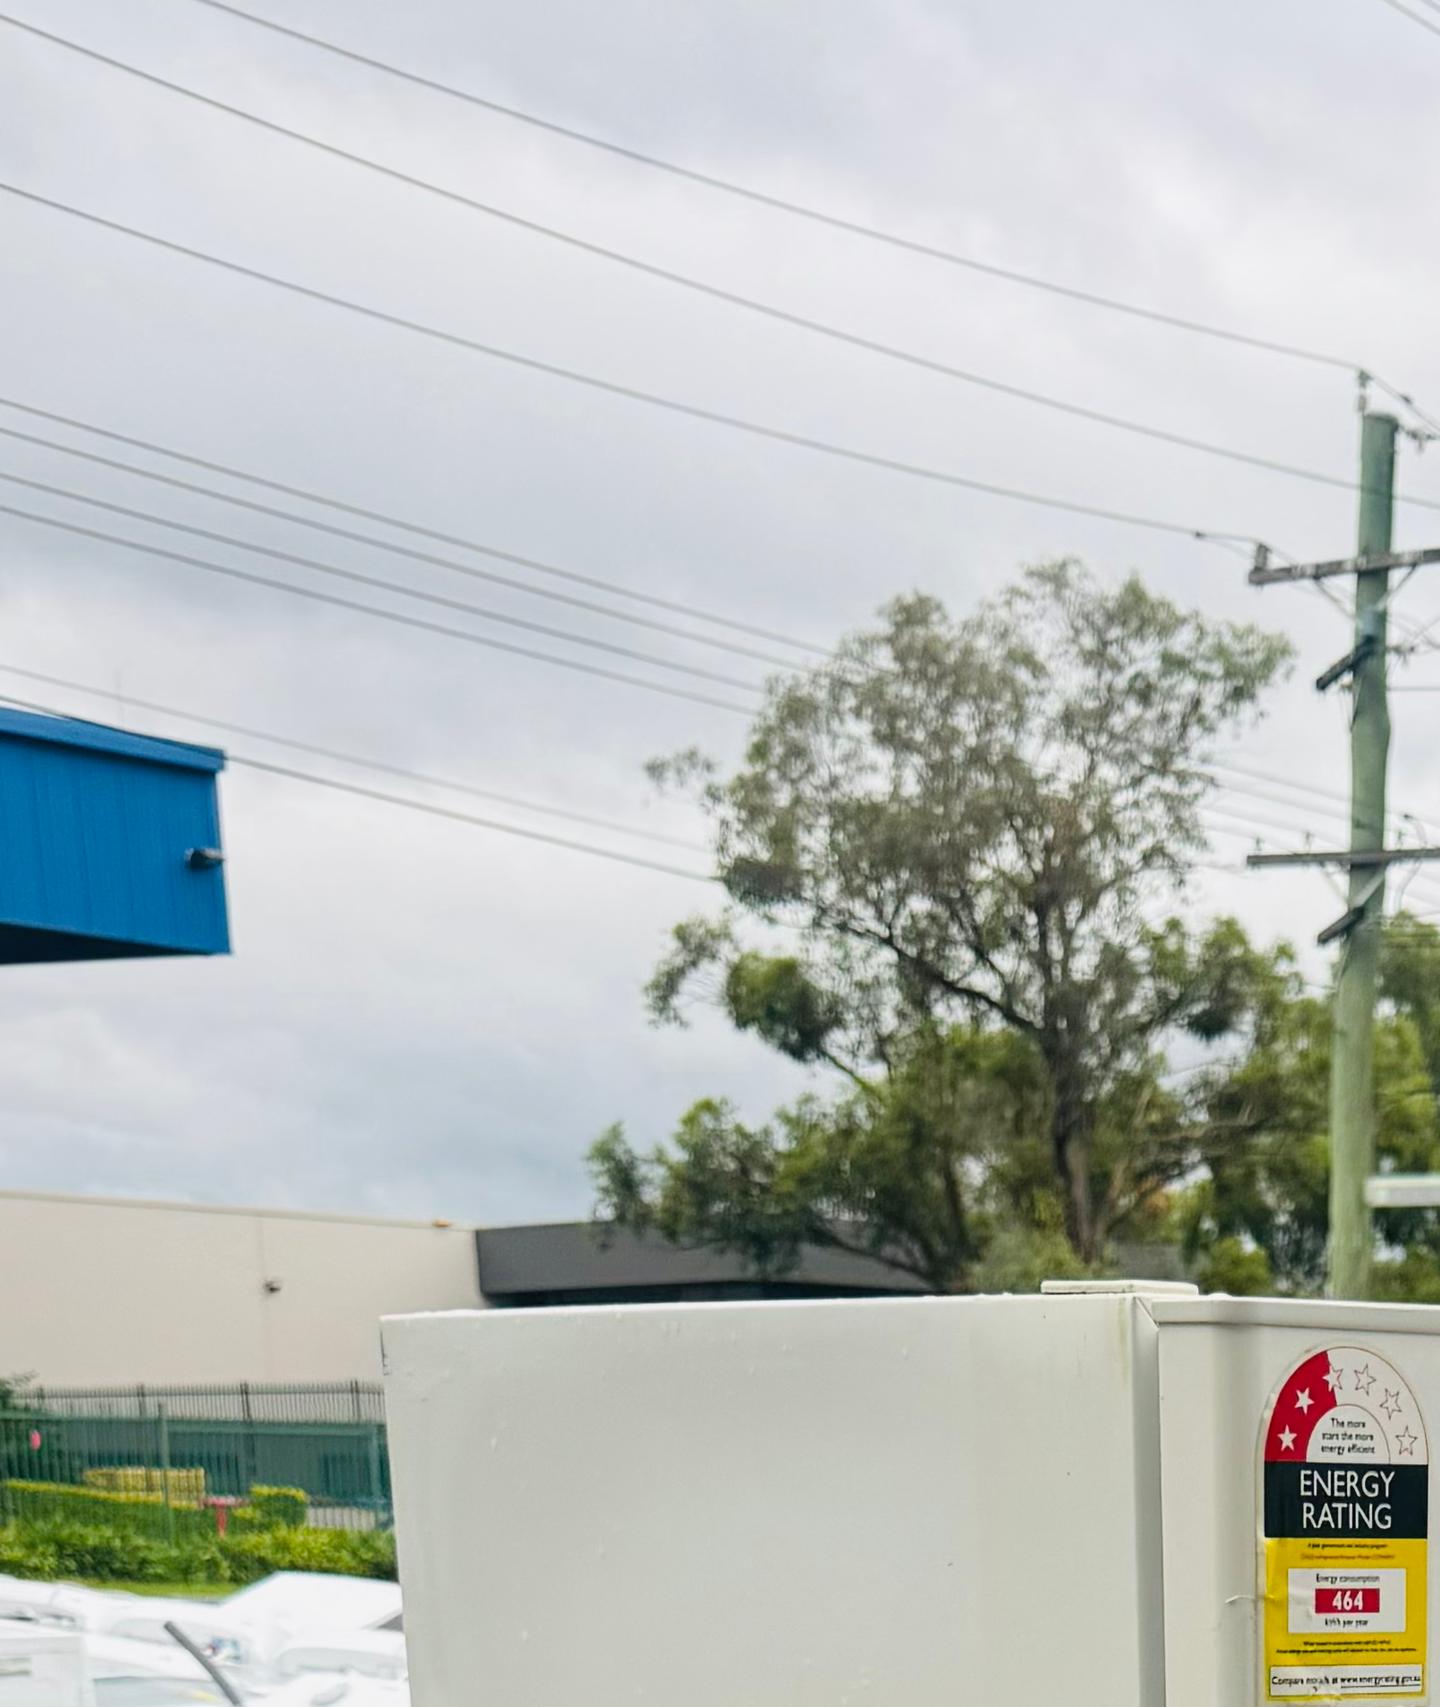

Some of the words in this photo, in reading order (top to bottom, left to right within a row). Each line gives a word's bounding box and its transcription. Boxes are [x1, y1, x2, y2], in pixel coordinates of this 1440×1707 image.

[1300, 1469, 1395, 1498] ENERGY
[1302, 1502, 1392, 1530] RATING
[1332, 1590, 1363, 1611] 464
